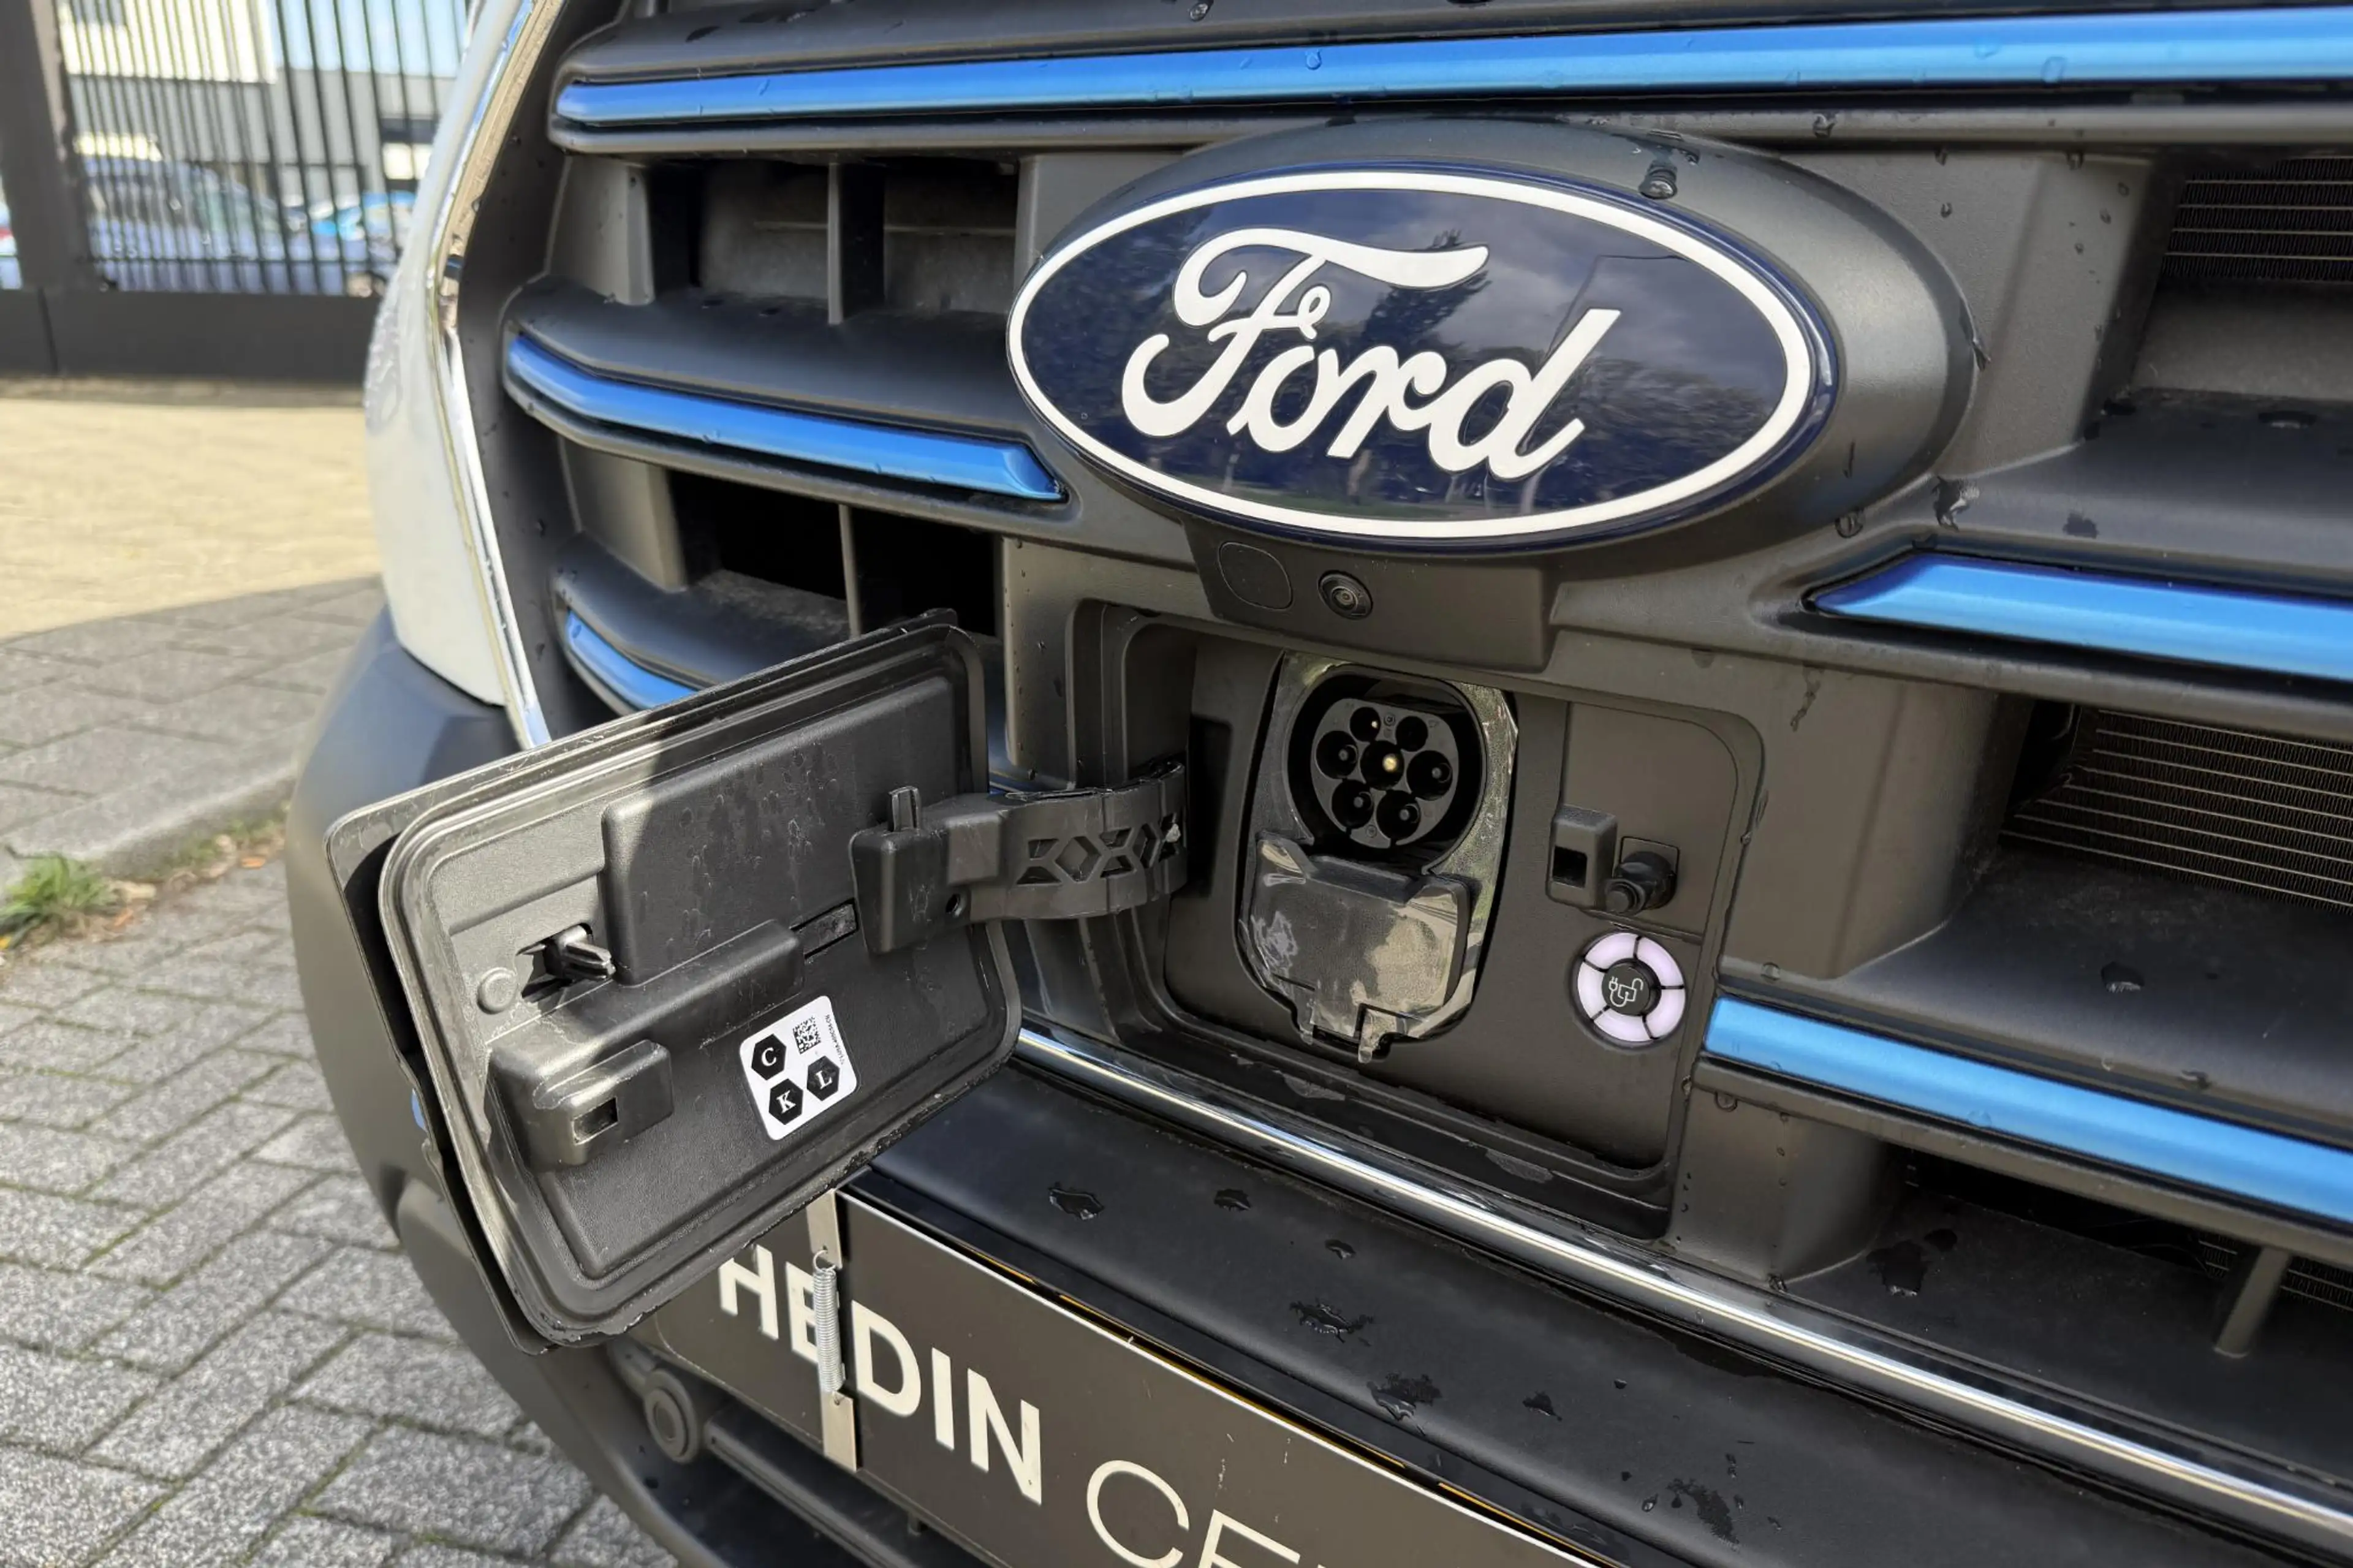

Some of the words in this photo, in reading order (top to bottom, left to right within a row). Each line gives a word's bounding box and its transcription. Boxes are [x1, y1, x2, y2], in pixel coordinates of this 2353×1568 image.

[1121, 227, 1621, 479] Ford
[761, 1047, 777, 1066] C
[776, 1090, 796, 1114] K
[816, 1070, 832, 1089] L
[718, 1244, 1042, 1505] HEDIN
[1086, 1460, 1327, 1568] CE
